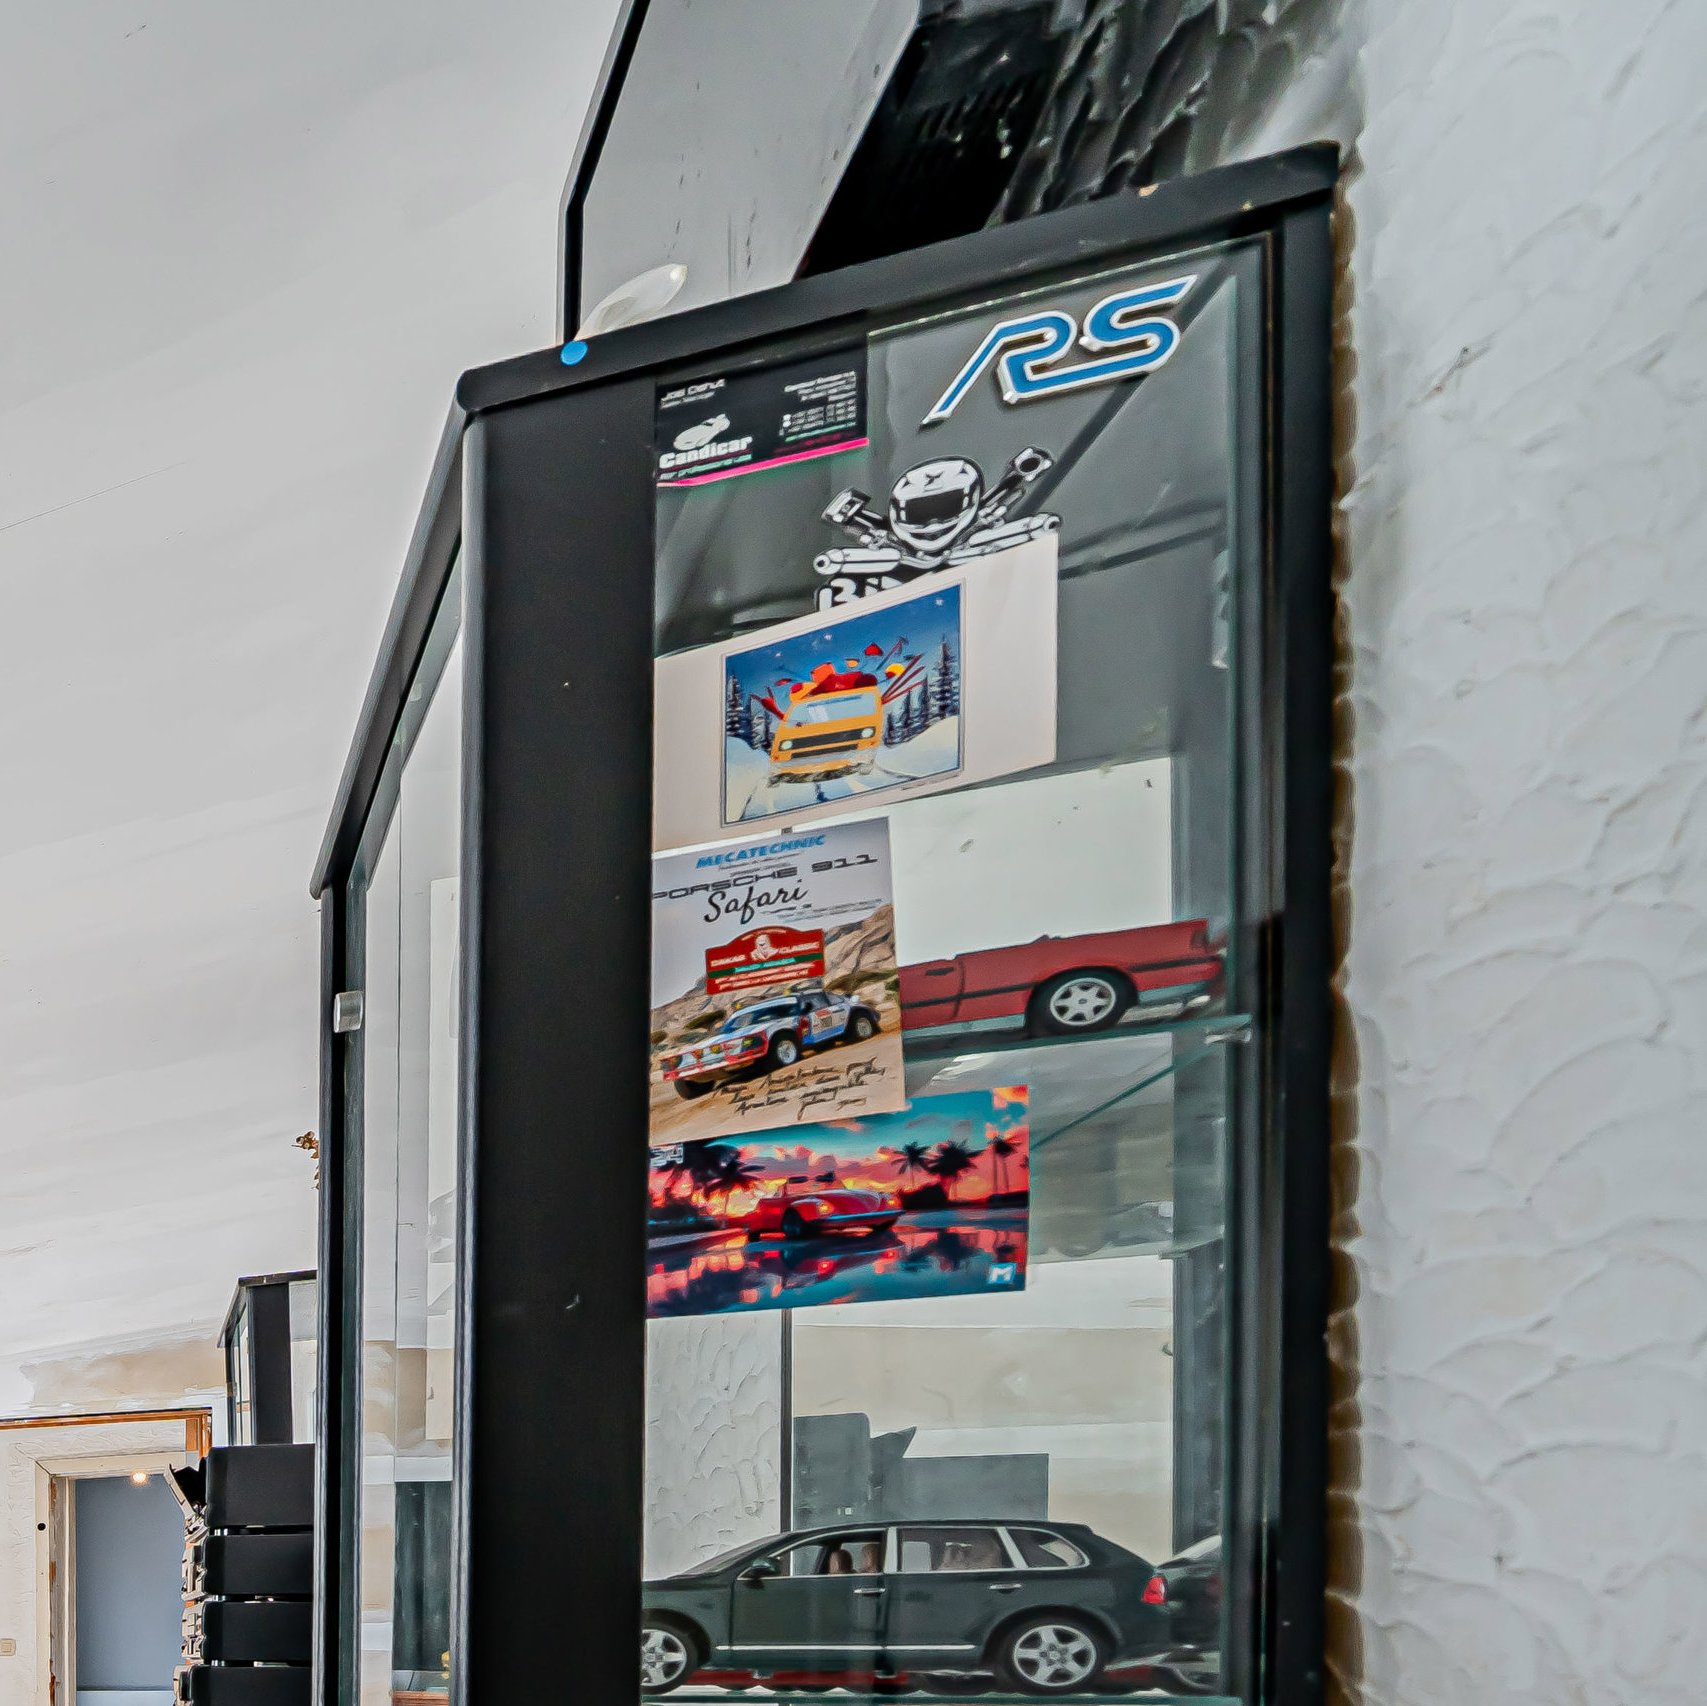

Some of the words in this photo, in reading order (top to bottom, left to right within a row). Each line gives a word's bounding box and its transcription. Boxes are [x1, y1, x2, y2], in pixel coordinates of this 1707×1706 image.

[920, 275, 1198, 426] RS
[811, 853, 878, 873] 911
[703, 878, 809, 924] Safari
